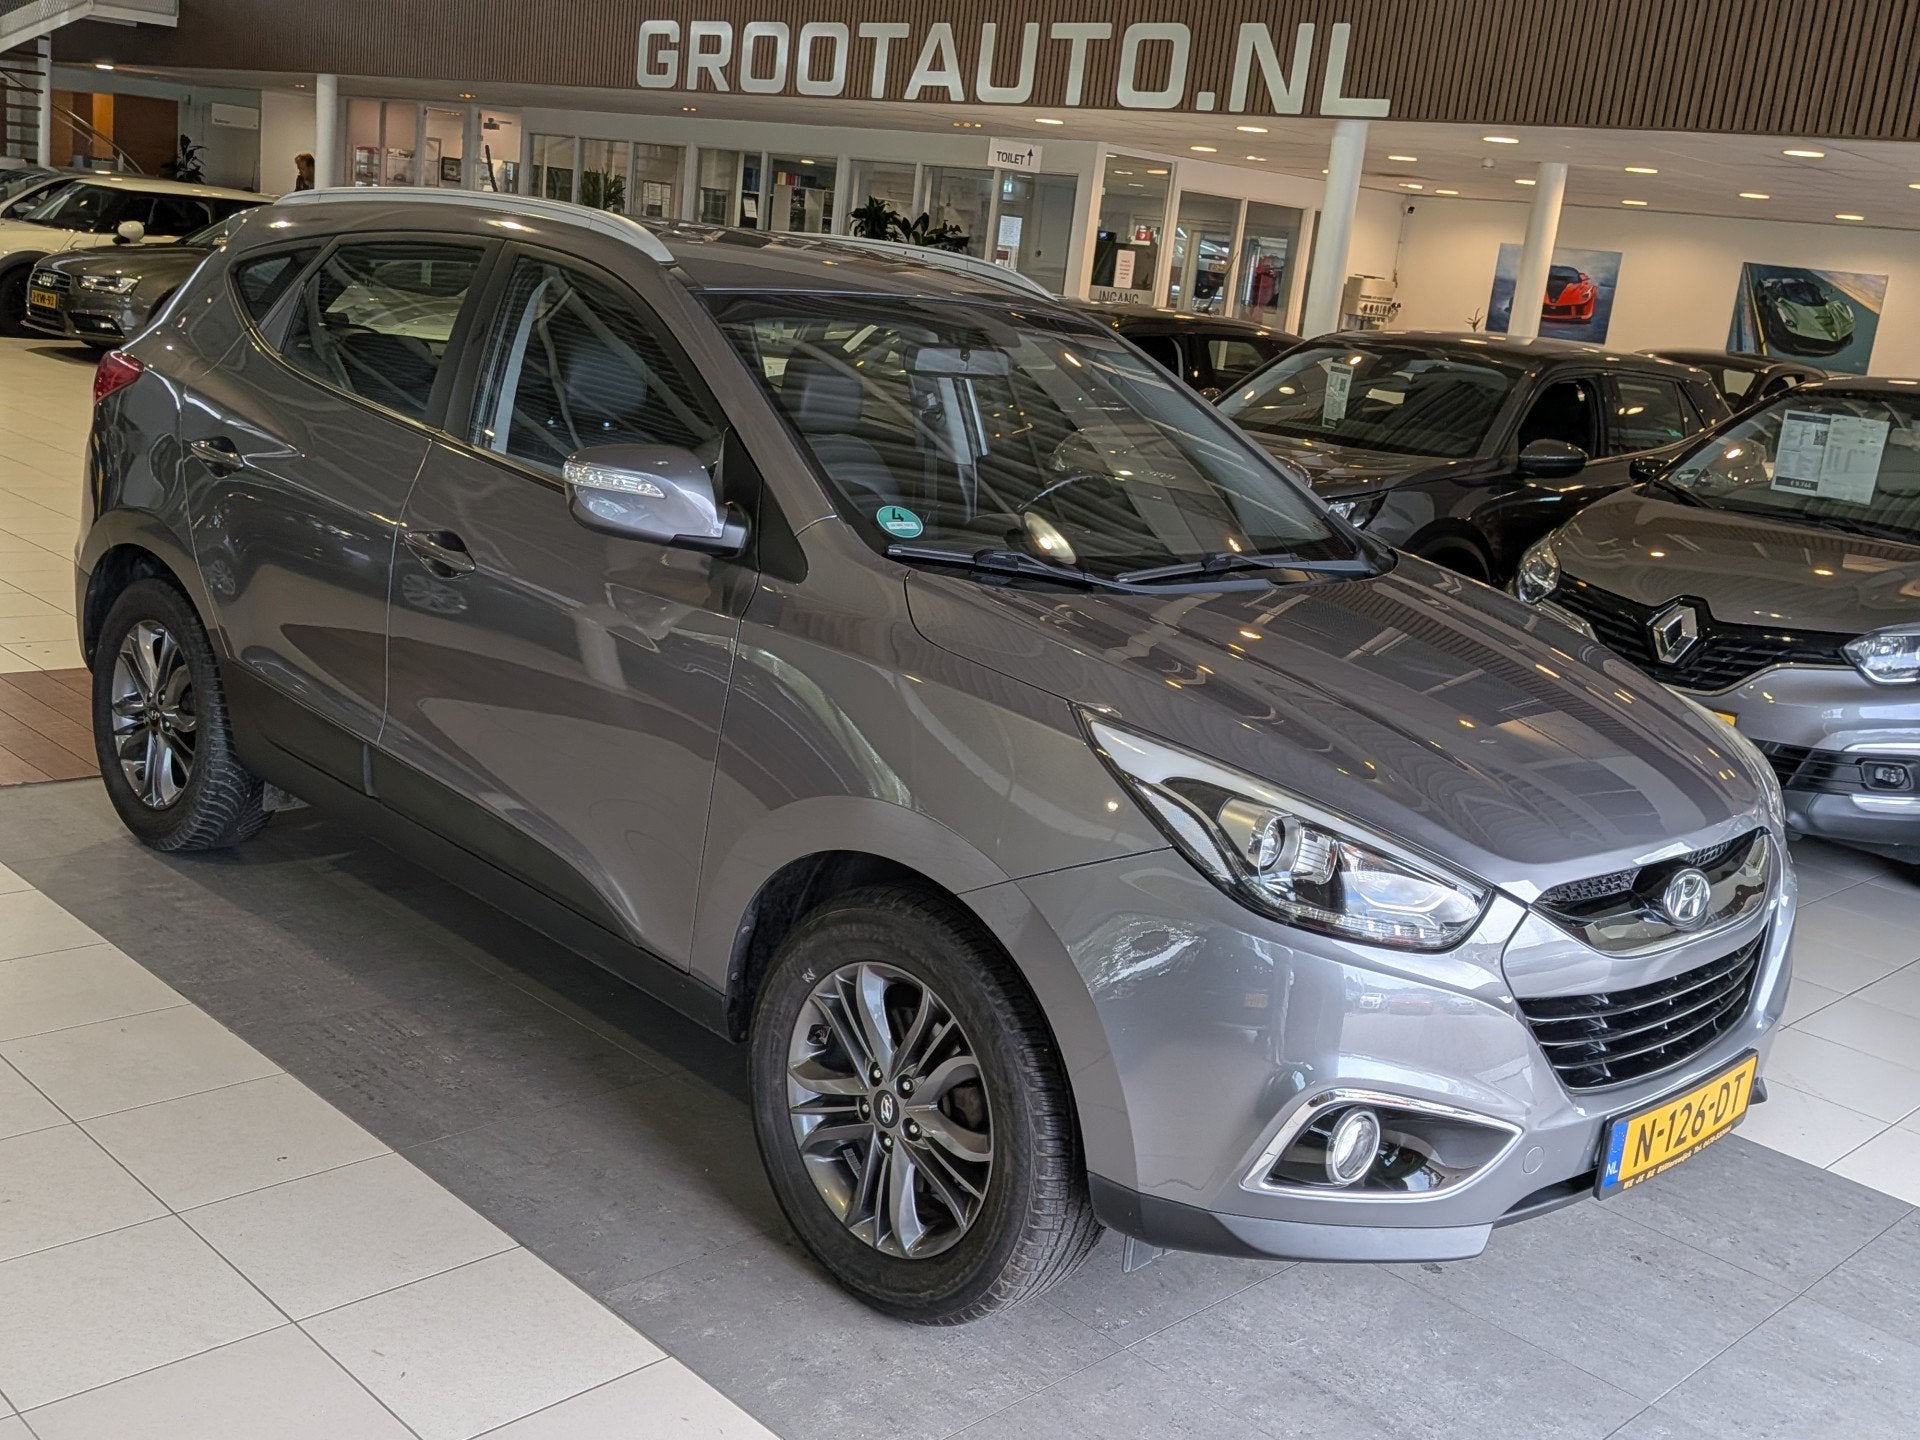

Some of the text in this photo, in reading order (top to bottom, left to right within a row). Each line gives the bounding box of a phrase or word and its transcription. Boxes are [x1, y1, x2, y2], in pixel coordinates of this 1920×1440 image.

[637, 19, 1391, 118] GROOTAUTO.NL
[996, 150, 1026, 166] TOILET
[1099, 290, 1140, 305] INGANG
[1633, 1069, 1747, 1168] N-126-DT
[1605, 1160, 1618, 1178] NL
